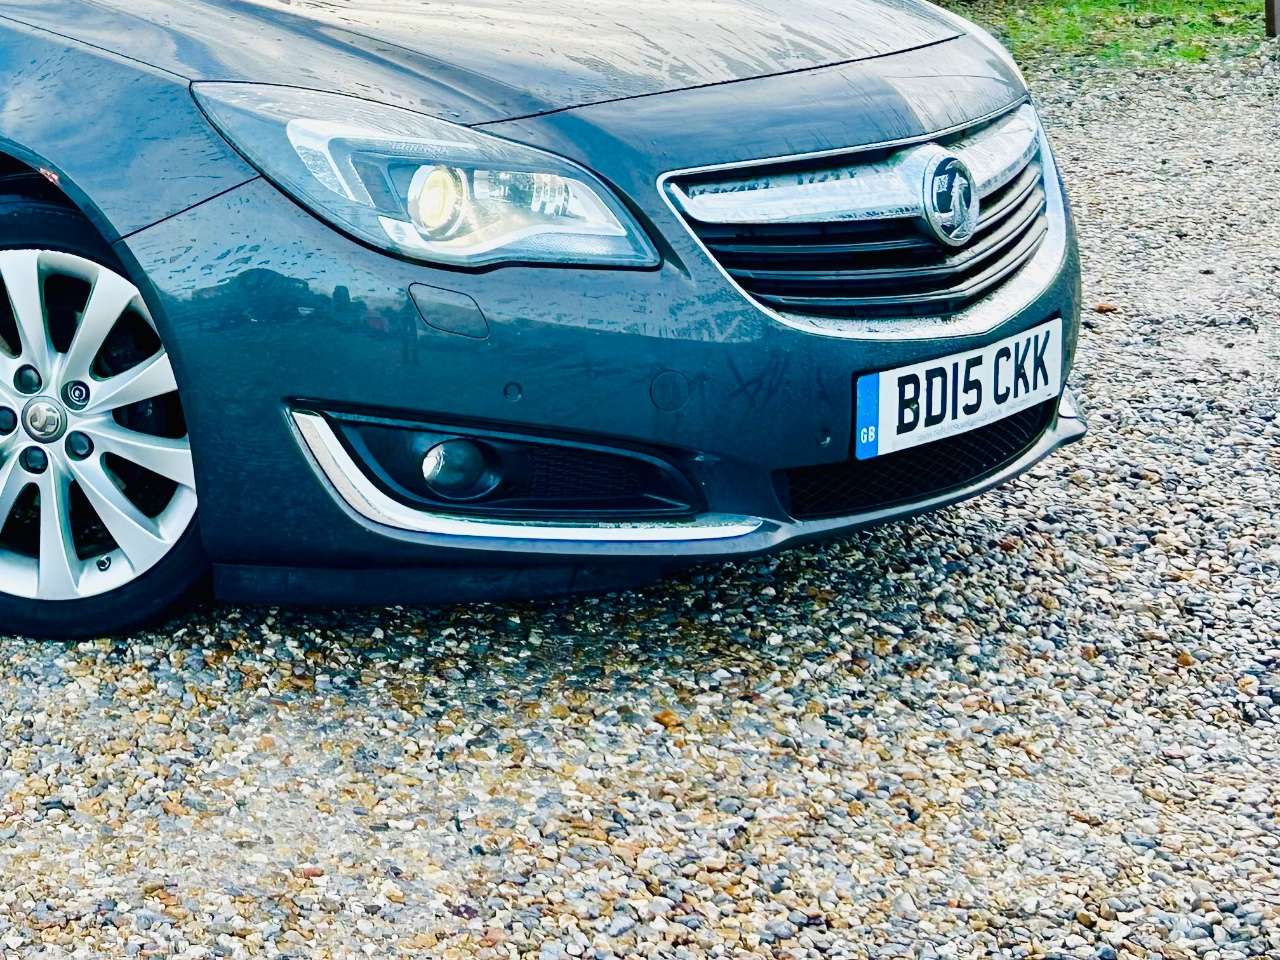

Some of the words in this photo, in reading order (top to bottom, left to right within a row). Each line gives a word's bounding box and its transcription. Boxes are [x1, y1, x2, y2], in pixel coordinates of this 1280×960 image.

[896, 354, 984, 436] BD15
[993, 329, 1052, 405] CKK
[860, 425, 876, 445] GB
